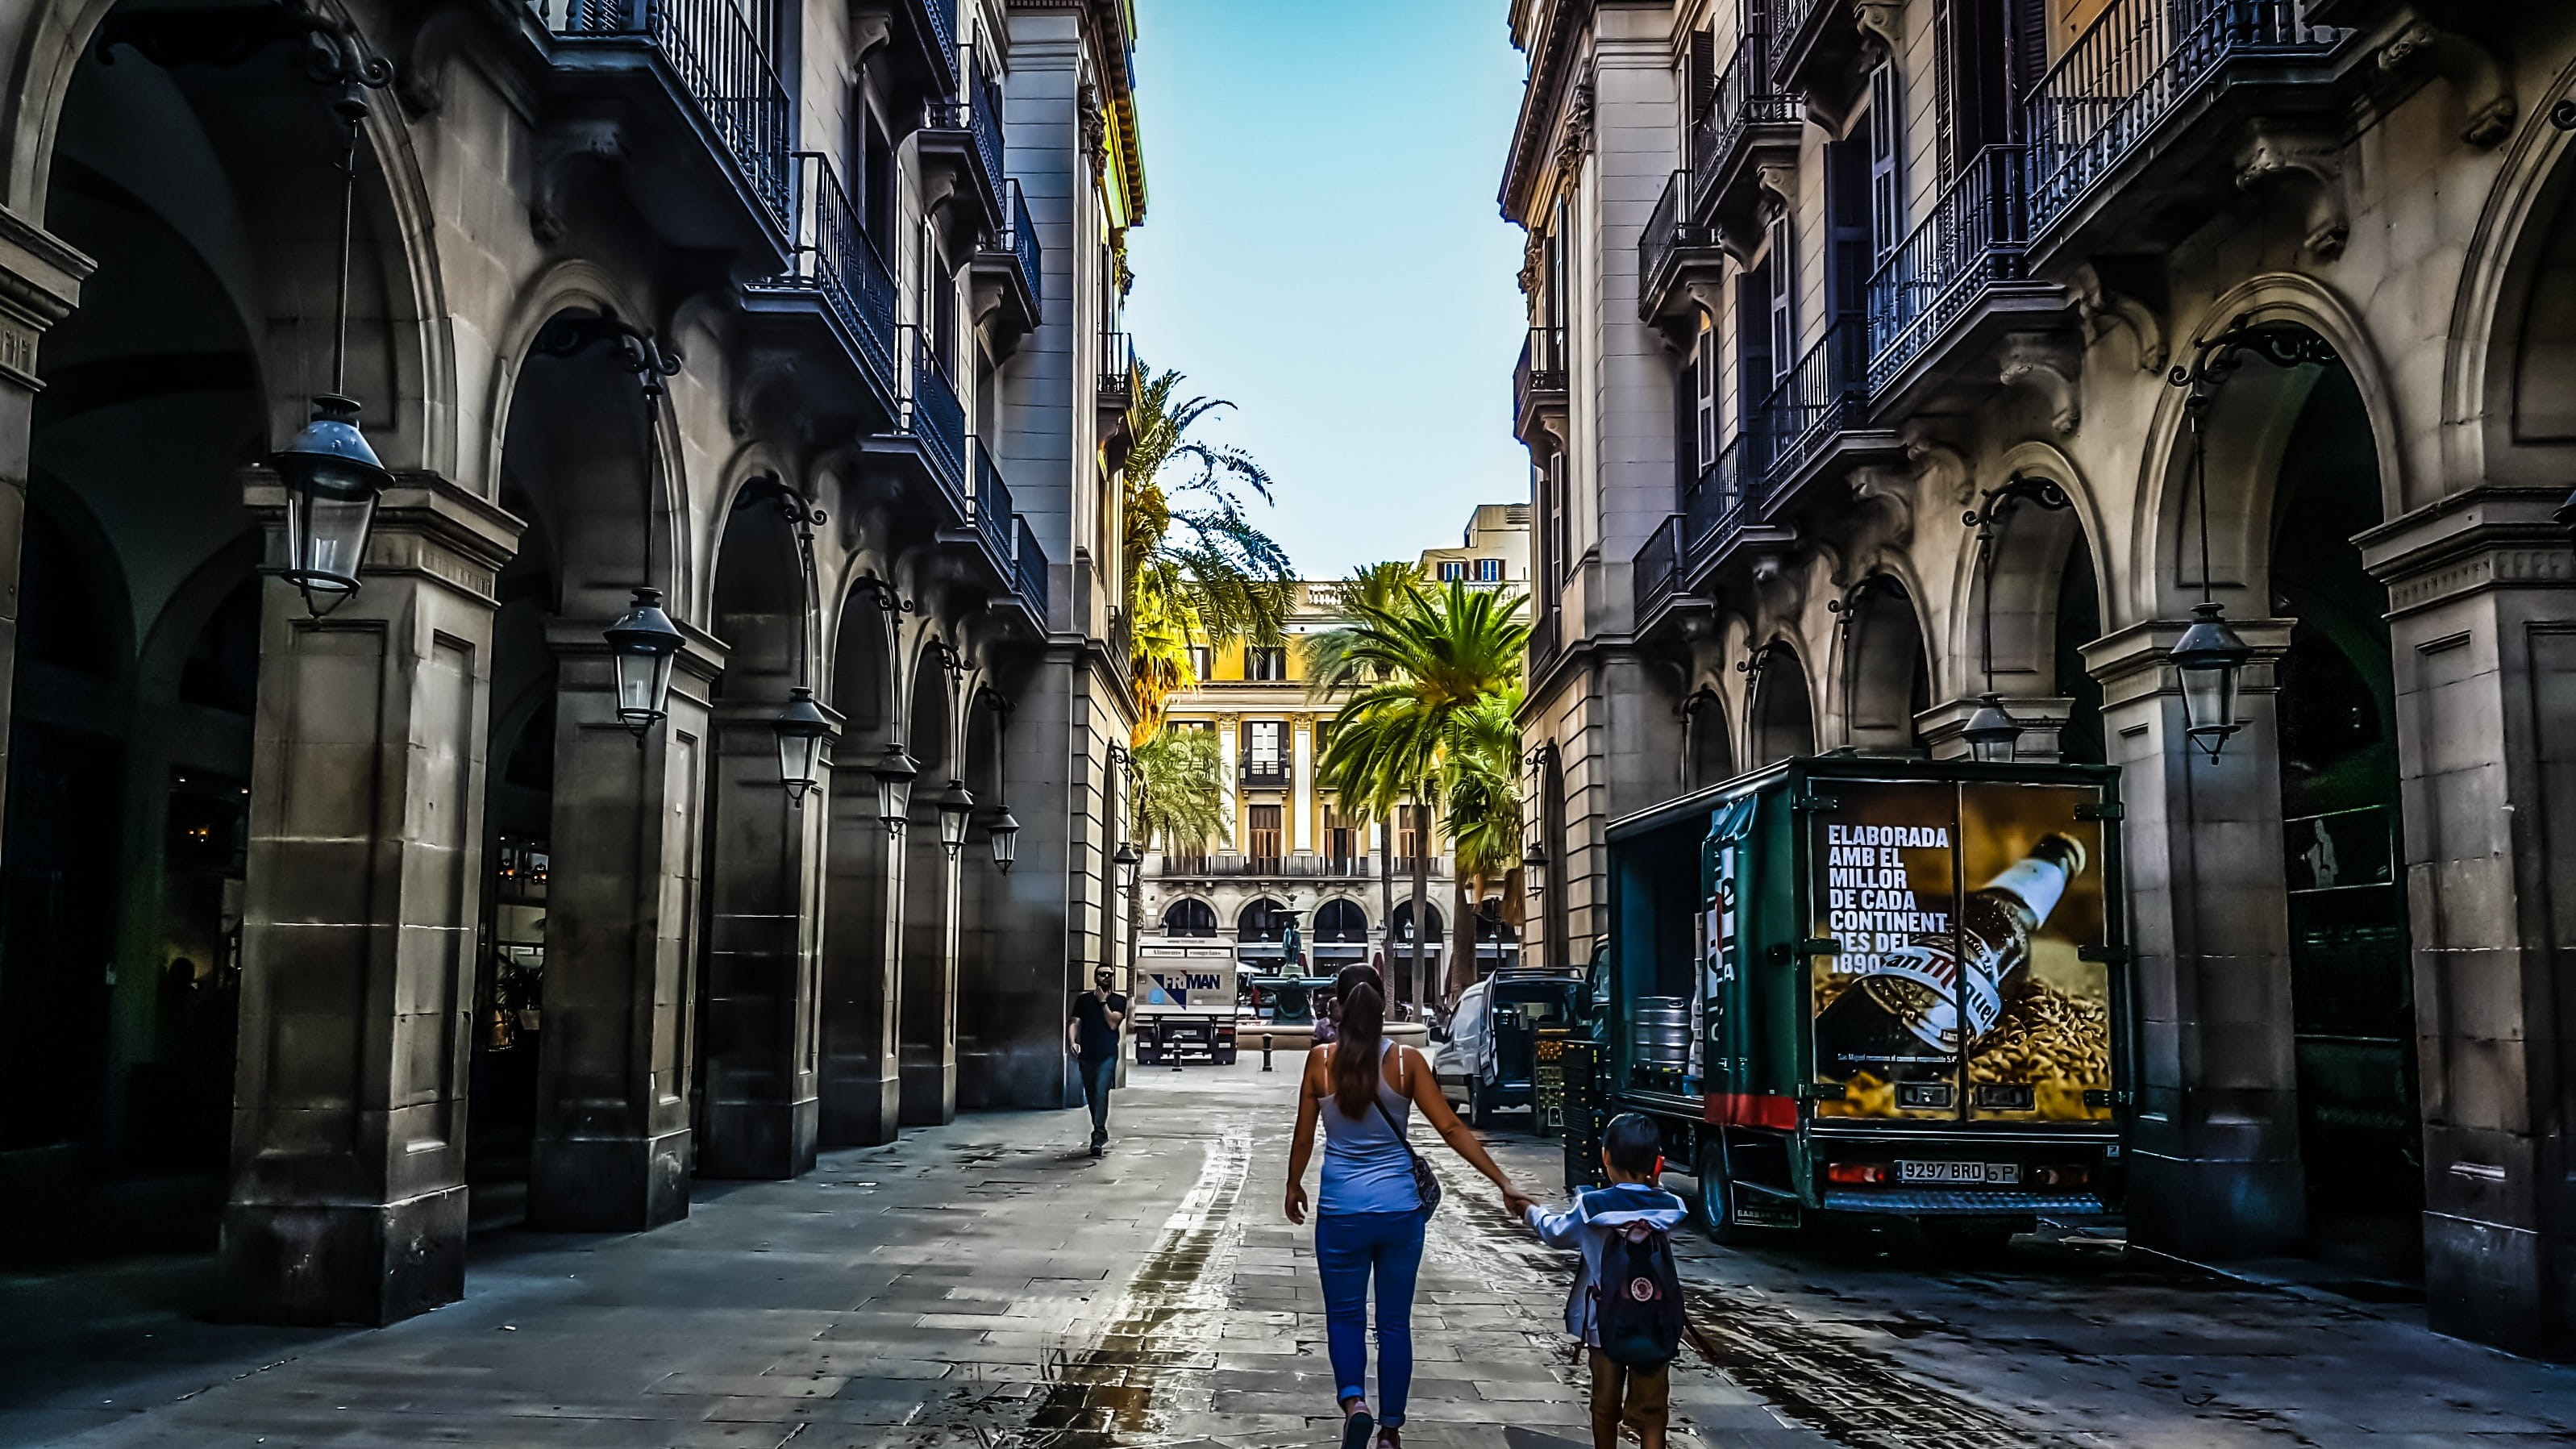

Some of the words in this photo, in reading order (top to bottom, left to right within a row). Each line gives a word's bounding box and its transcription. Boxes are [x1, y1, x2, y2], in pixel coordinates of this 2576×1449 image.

[1829, 825, 1950, 848] ELABORADA
[1829, 847, 1875, 868] AMB
[1880, 847, 1904, 868] EL
[1829, 868, 1908, 889] MILLOR
[1830, 889, 1856, 910] DE
[1861, 890, 1917, 911] CADA
[1830, 911, 1948, 933] CONTINENT
[1829, 932, 1871, 952] DES
[1875, 933, 1914, 953] DEL
[1832, 953, 1881, 974] 1890
[1879, 954, 1924, 971] an
[1921, 951, 1996, 1027] Muel
[1905, 1163, 1946, 1178] 9297
[1951, 1164, 1982, 1180] BRD
